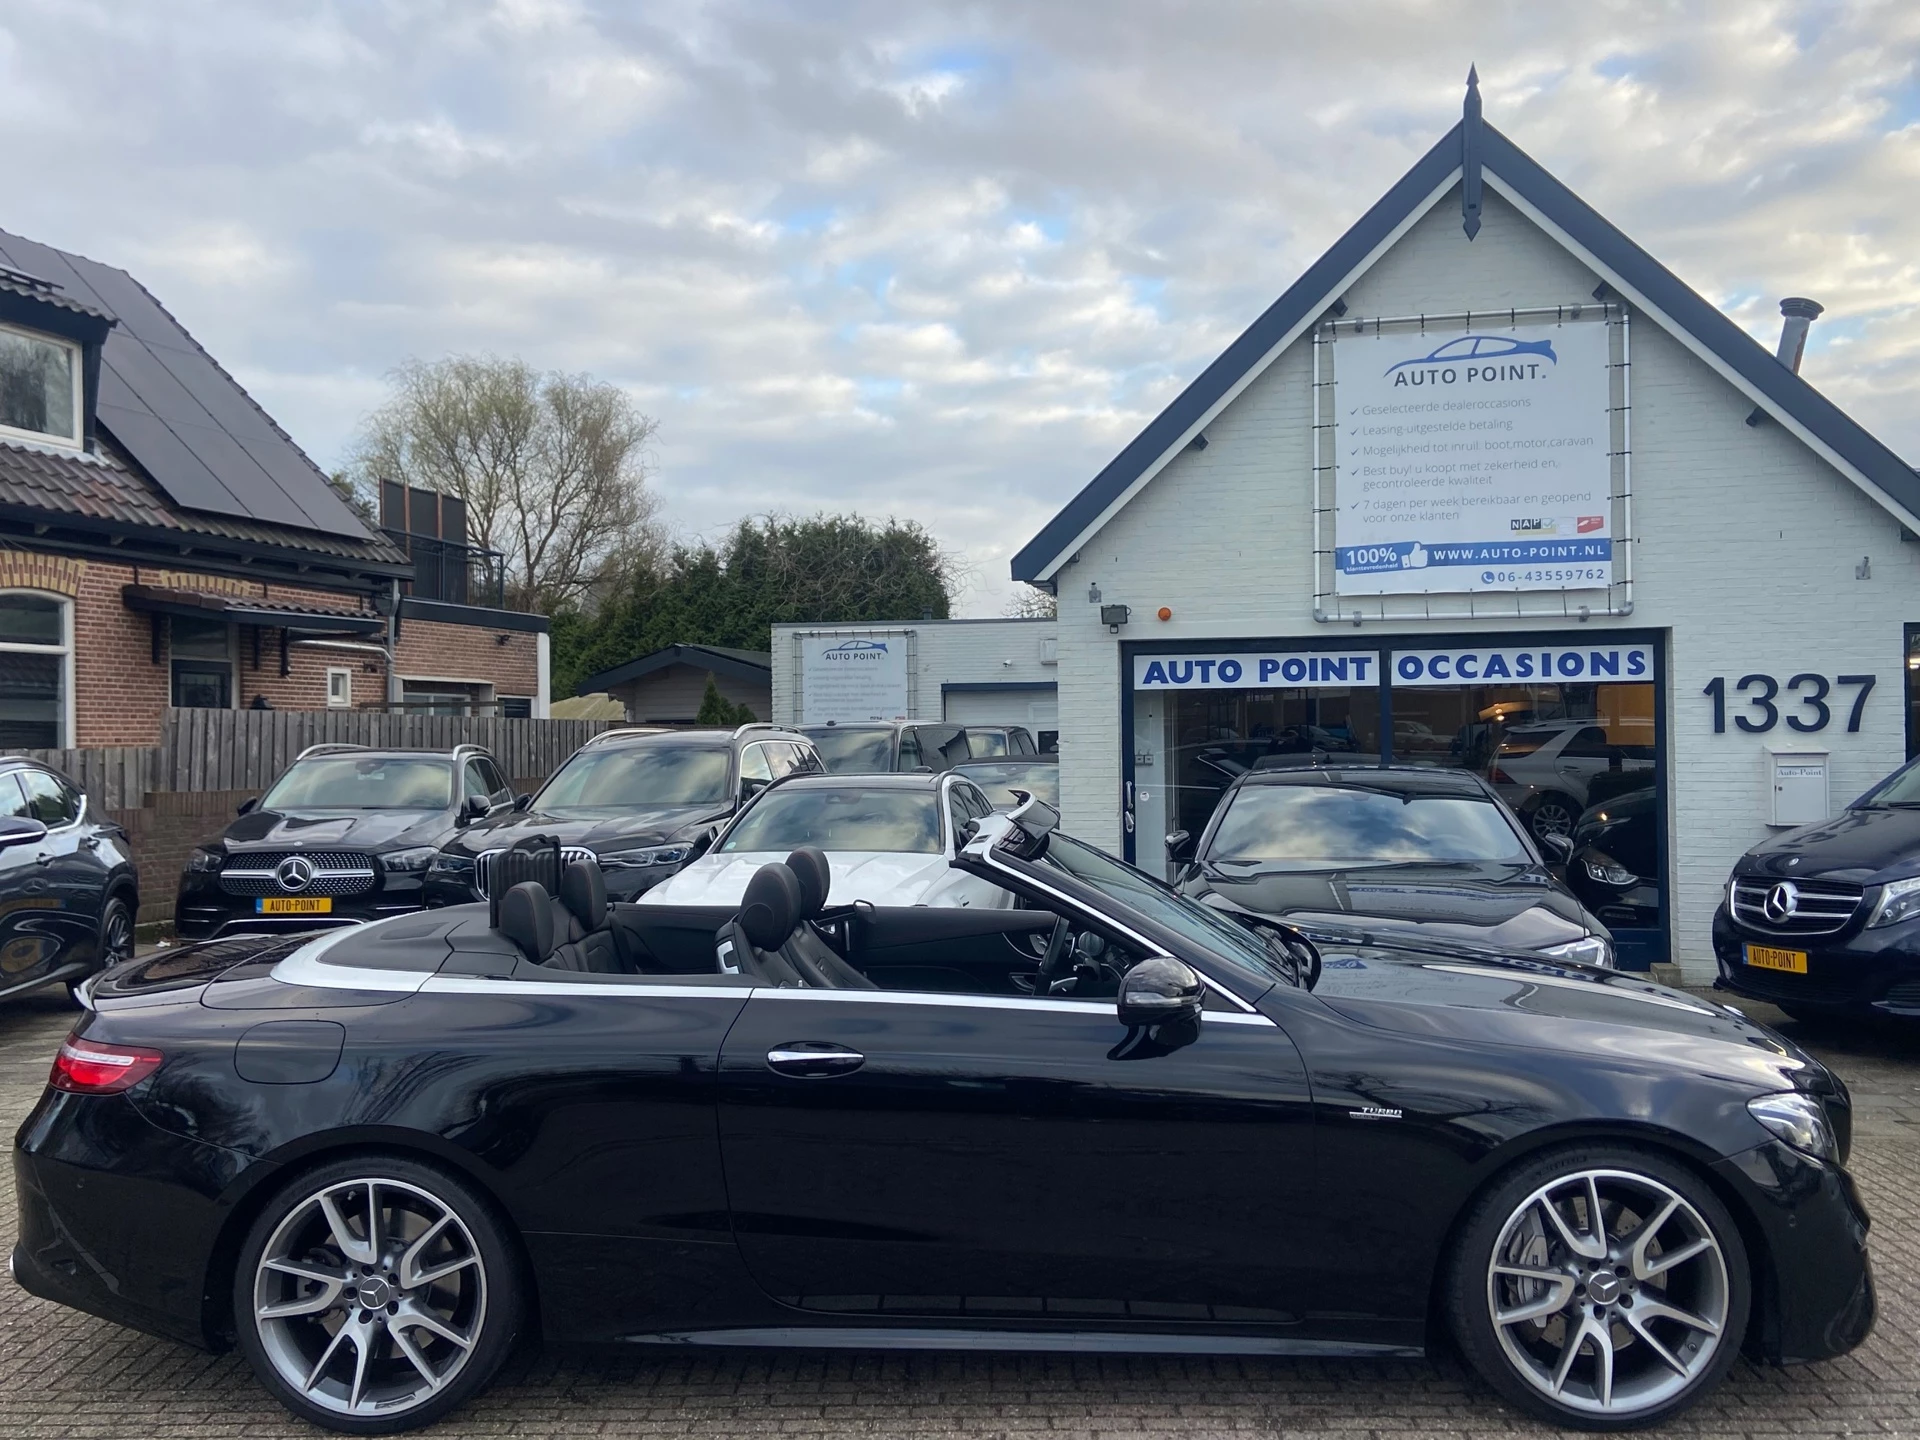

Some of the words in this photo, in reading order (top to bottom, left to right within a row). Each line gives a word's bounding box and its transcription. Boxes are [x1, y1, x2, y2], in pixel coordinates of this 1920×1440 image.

[1393, 368, 1457, 387] AUTO
[1362, 402, 1440, 416] Geselecteerde
[1443, 398, 1531, 411] dealeroccasions
[1362, 421, 1466, 436] Leasing-uitgestelde
[1469, 419, 1513, 431] betaling
[1363, 441, 1430, 457] Mogelijkheid
[1433, 443, 1448, 452] tot
[1363, 466, 1387, 476] Best
[1415, 465, 1422, 474] u
[1425, 463, 1456, 475] koopt
[1460, 462, 1481, 472] met
[1484, 459, 1538, 471] zekerheid
[1363, 477, 1445, 492] gecontroleerde
[1448, 475, 1492, 485] kwaliteit
[1363, 500, 1370, 509] 7
[1373, 499, 1406, 512] dagen
[1409, 499, 1427, 511] per
[1430, 496, 1458, 507] week
[1461, 494, 1520, 506] bereikbaar
[1524, 494, 1538, 503] en
[1541, 491, 1591, 506] geopend
[1363, 514, 1387, 523] voor
[1390, 513, 1416, 523] onze
[1419, 511, 1460, 522] klanten
[1511, 518, 1541, 529] NAP
[1346, 547, 1397, 565] 100%
[1433, 545, 1604, 560] WWW.AUTO-POINT.NL
[1497, 568, 1604, 582] 06-43559762
[825, 653, 850, 661] AUTO
[1397, 650, 1646, 680] OCCASIONS
[1142, 659, 1243, 684] AUTO
[1259, 656, 1372, 683] POINT
[1702, 673, 1876, 733] 1337
[1777, 768, 1822, 776] Auto-Point
[269, 899, 320, 912] AUTO-POINT
[1752, 949, 1796, 969] AUTO-POINT
